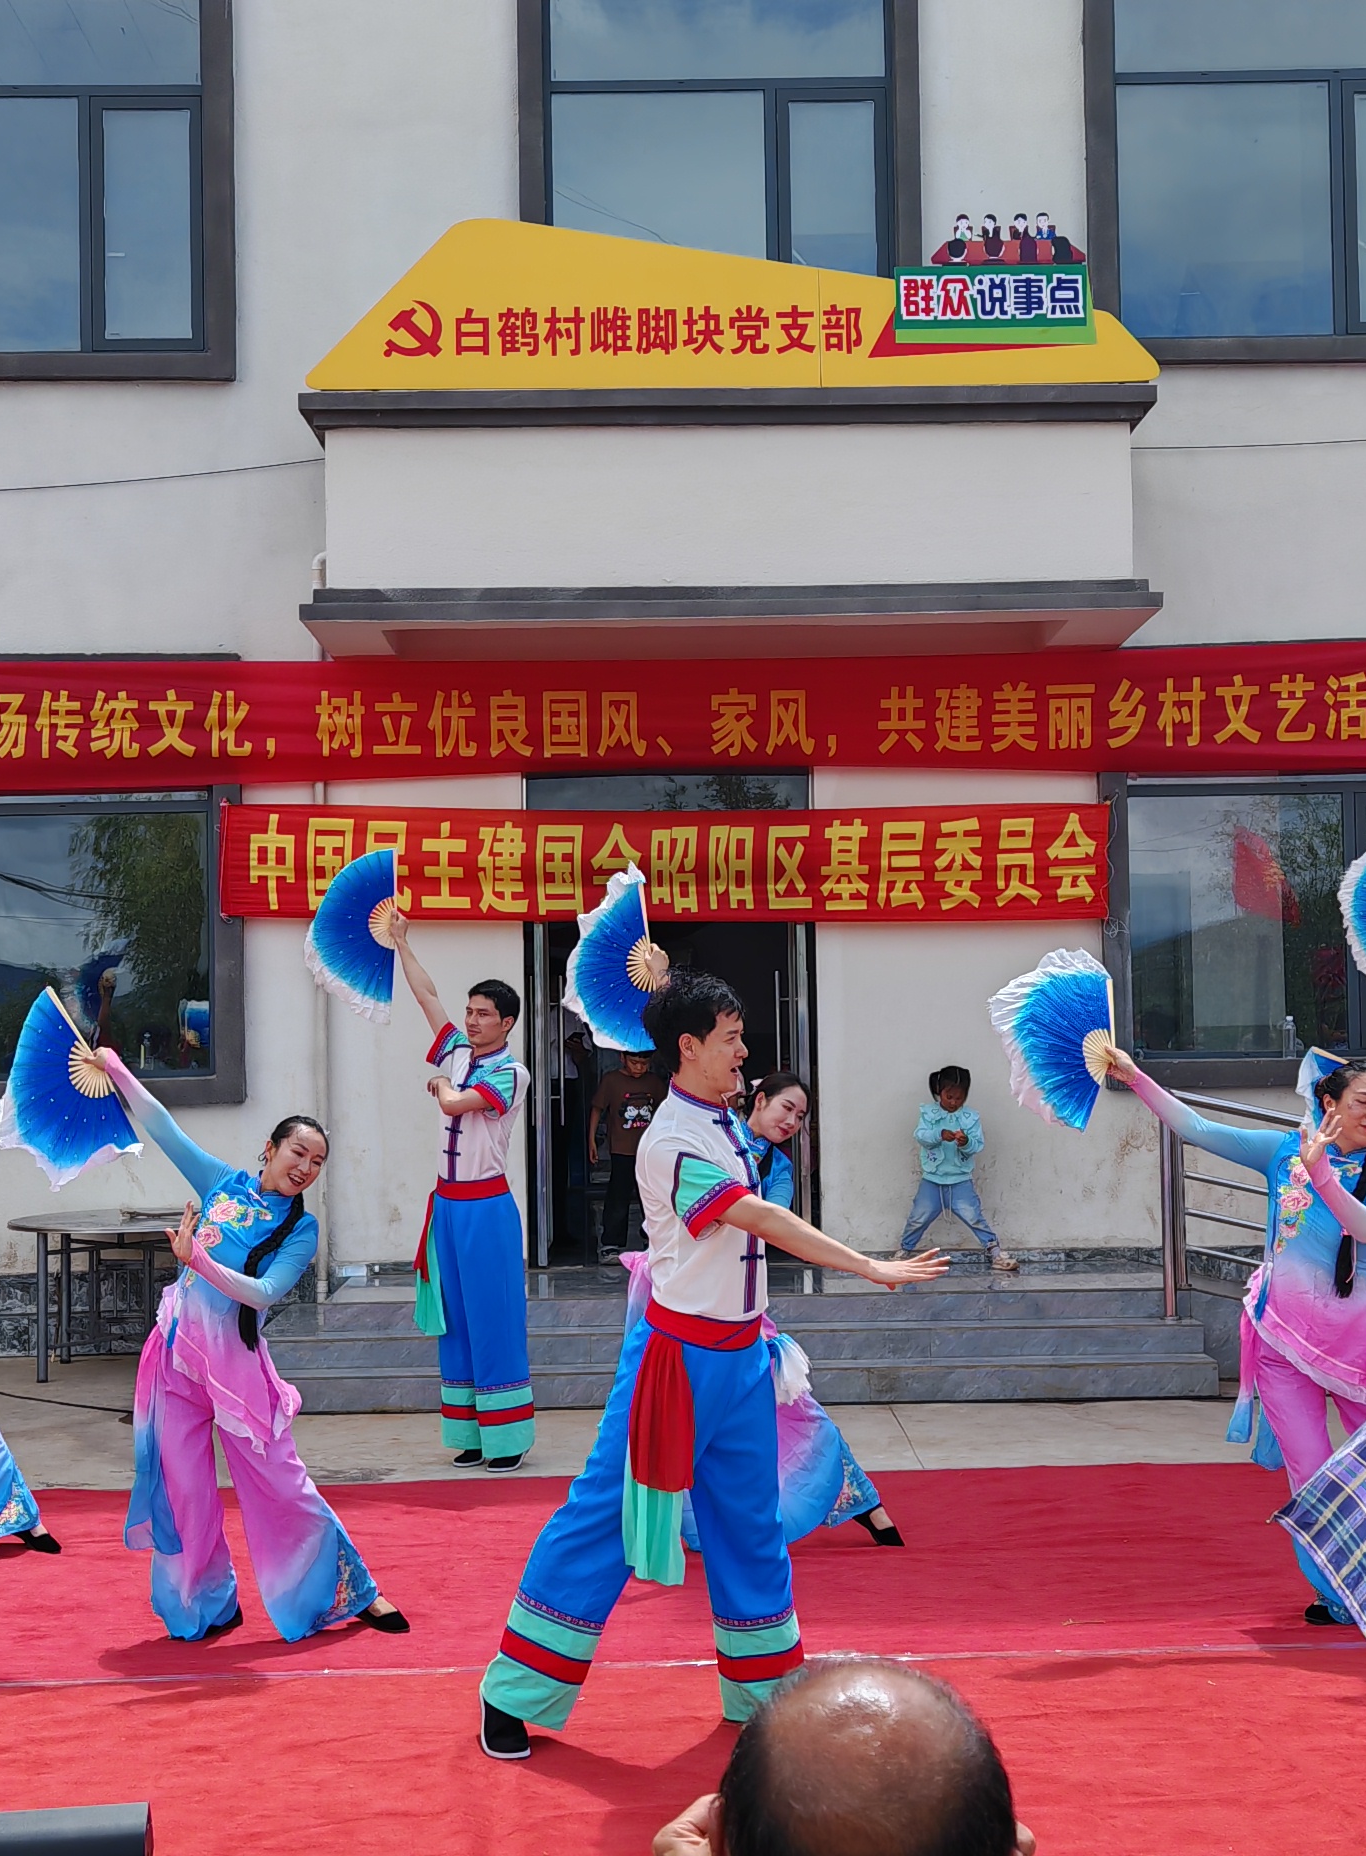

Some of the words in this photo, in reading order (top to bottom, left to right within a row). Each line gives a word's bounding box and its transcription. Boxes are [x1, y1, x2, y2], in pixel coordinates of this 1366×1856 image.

[901, 275, 1083, 318] 群众说事点
[454, 304, 863, 357] 白鹤村雌脚块党支部
